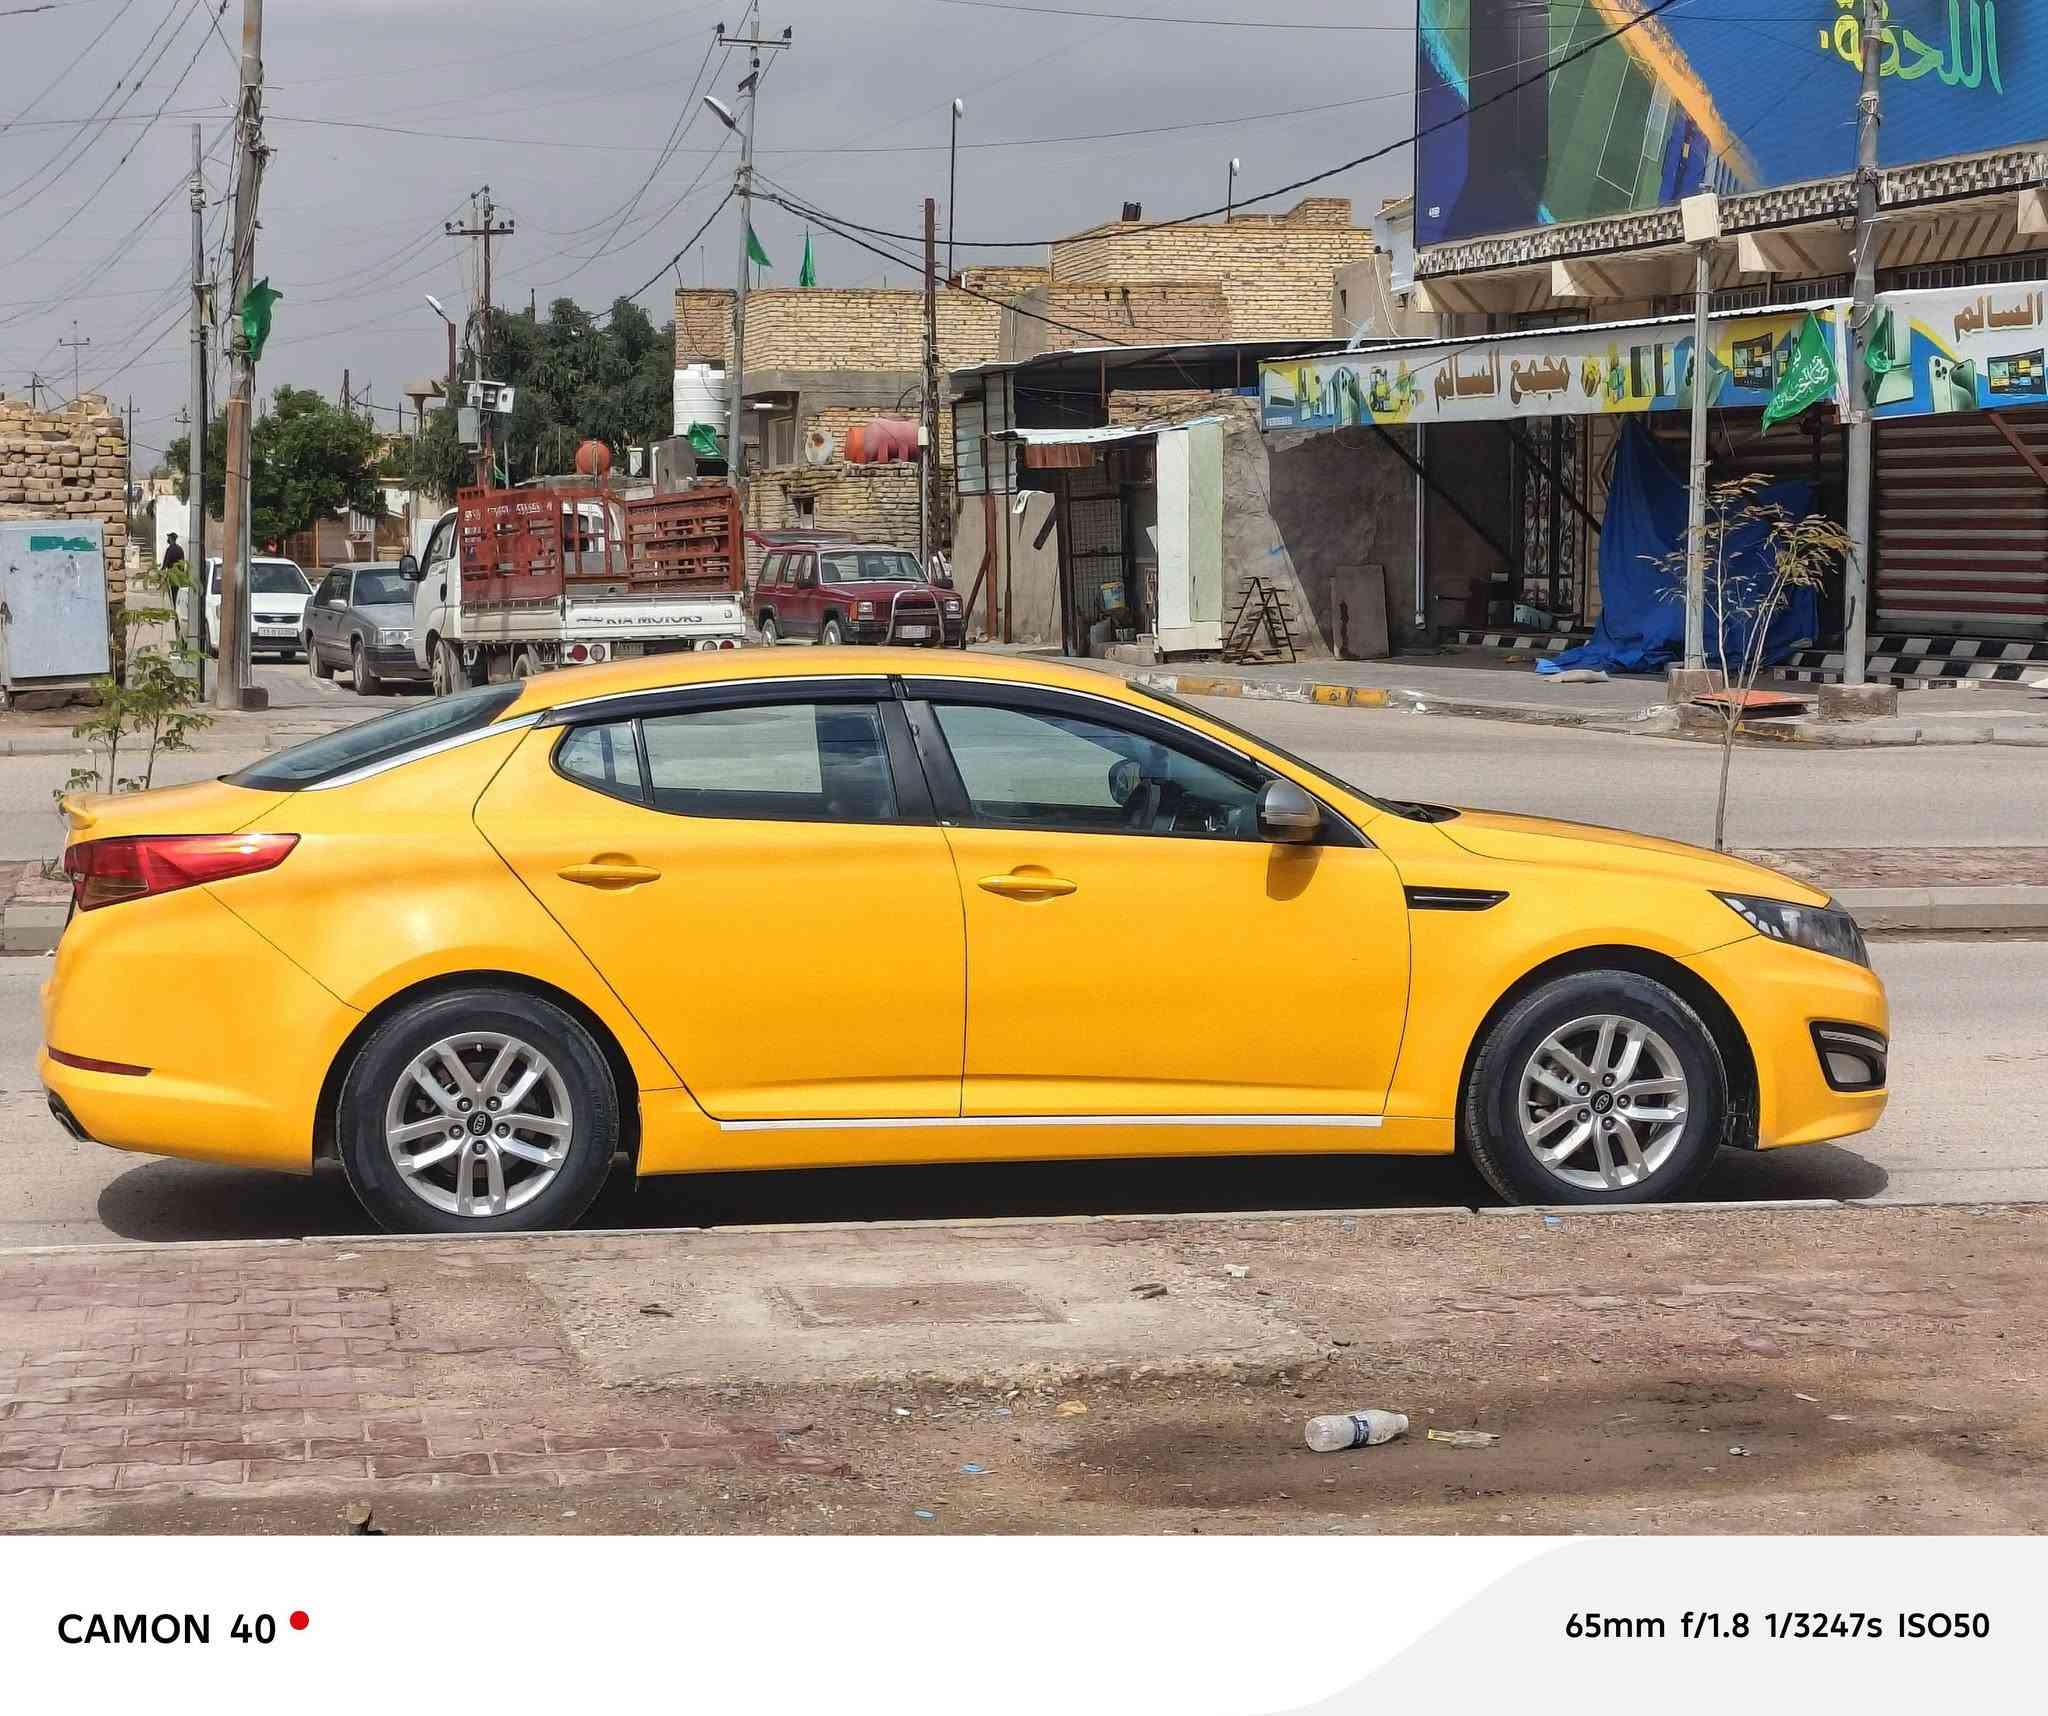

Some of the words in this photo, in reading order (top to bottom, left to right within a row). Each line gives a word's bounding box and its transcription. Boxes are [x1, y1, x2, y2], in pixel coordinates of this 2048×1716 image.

[1954, 291, 2044, 343] السالم
[1434, 349, 1501, 415] السالم
[1510, 355, 1570, 408] مجمع
